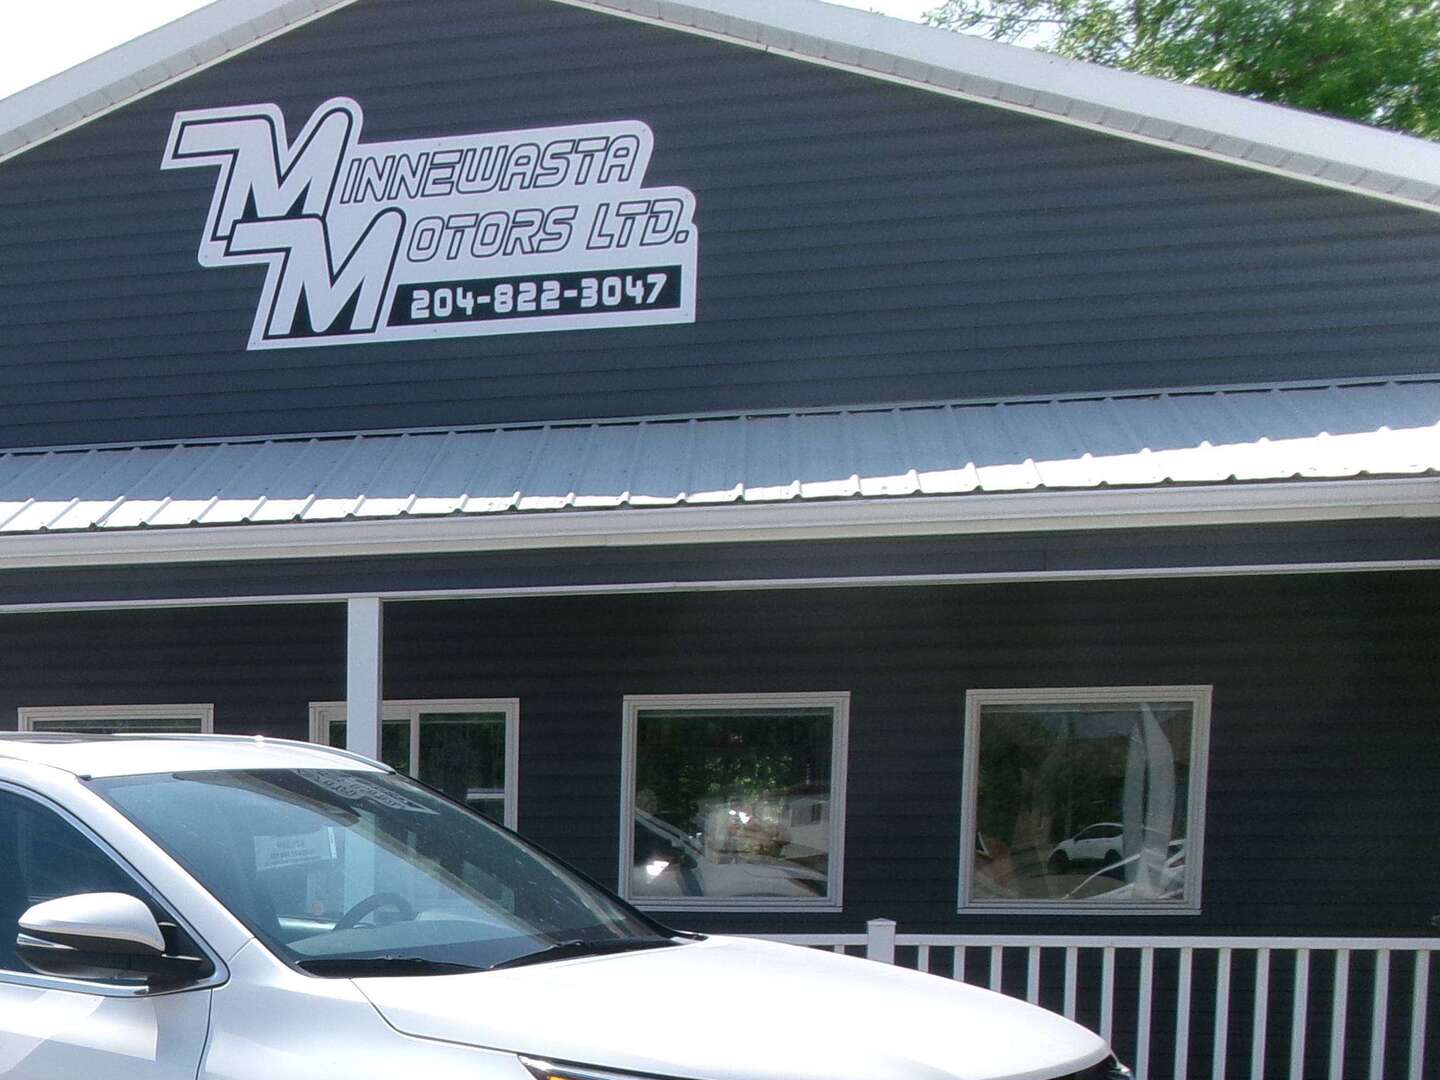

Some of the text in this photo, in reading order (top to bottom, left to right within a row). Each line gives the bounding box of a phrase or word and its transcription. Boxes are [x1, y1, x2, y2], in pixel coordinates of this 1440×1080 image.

[172, 106, 641, 241] MINNEWASTA
[223, 197, 690, 340] MOTORS LTD.
[410, 272, 669, 320] 204-822-3047
